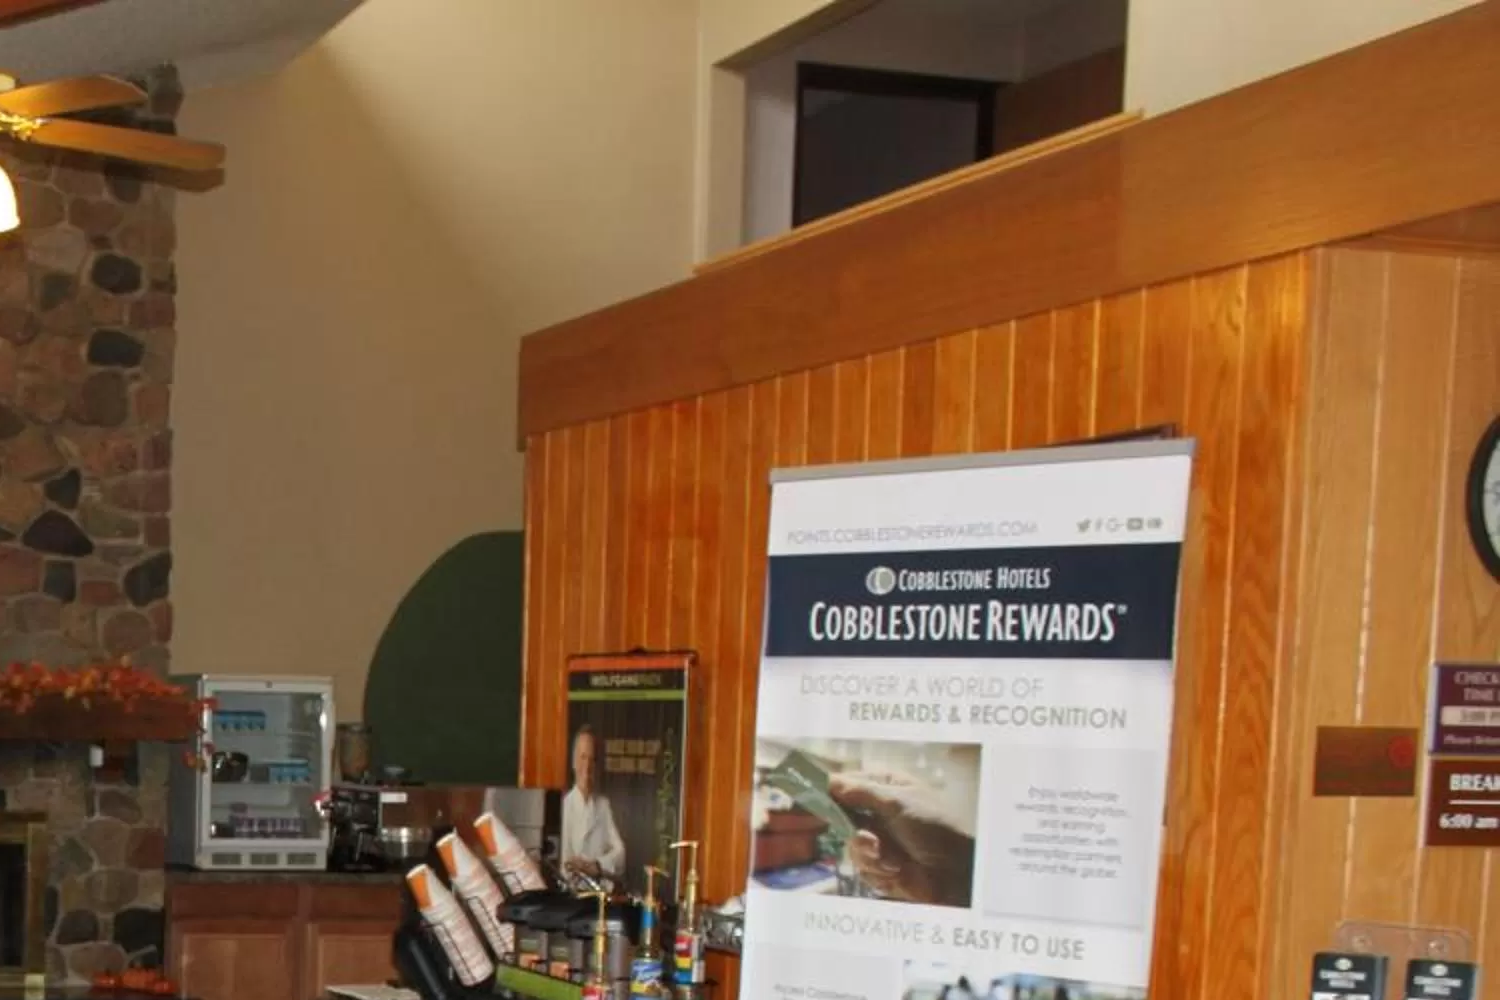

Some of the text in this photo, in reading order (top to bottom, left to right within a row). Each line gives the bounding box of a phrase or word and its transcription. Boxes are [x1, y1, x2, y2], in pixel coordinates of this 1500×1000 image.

[898, 566, 1052, 592] COBBLESTONE HOTELS
[809, 600, 982, 642] COBBLESTONE
[800, 674, 1045, 699] DISCOVER A WORLD OF
[849, 701, 1127, 730] REWARDS & RECOGNITION
[803, 911, 1086, 961] INNOVATIVE & EASY TO USE
